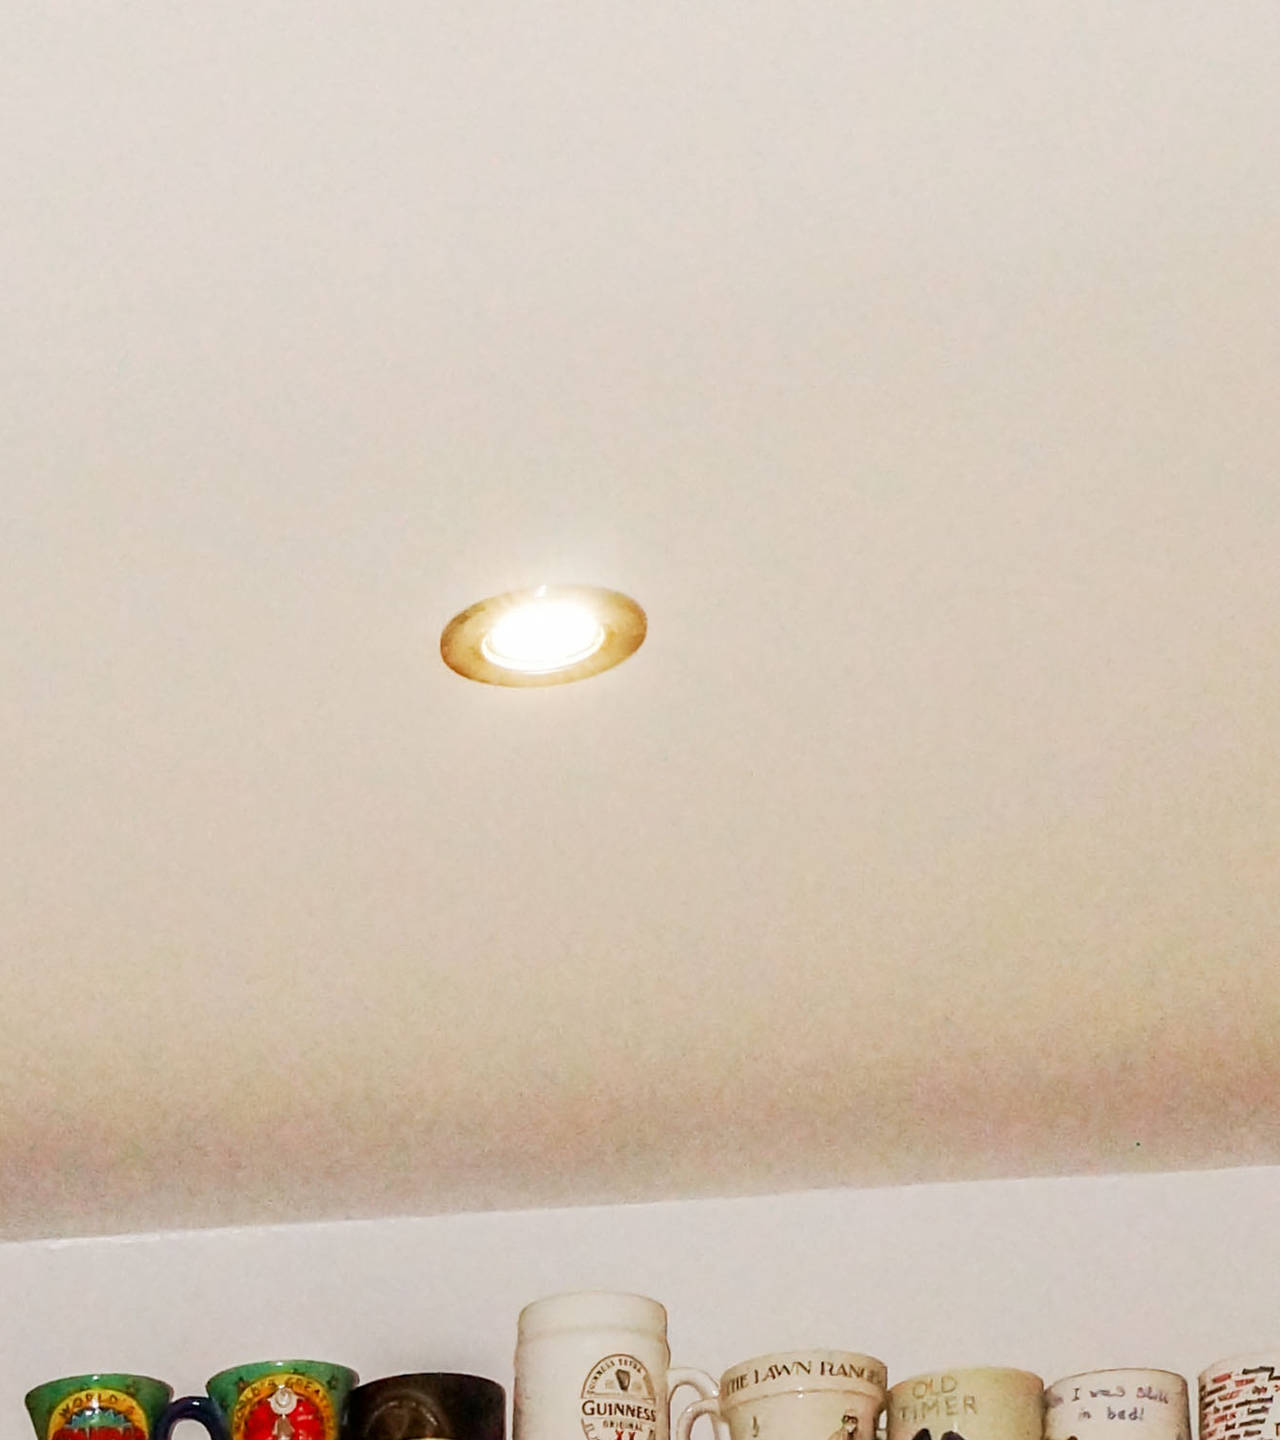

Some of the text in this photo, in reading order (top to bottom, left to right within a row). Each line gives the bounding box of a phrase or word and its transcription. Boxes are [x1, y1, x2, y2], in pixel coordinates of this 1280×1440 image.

[754, 1360, 812, 1384] LAWN
[912, 1375, 958, 1399] OLD
[582, 1400, 657, 1422] GUINNESS
[900, 1395, 977, 1420] TIMER
